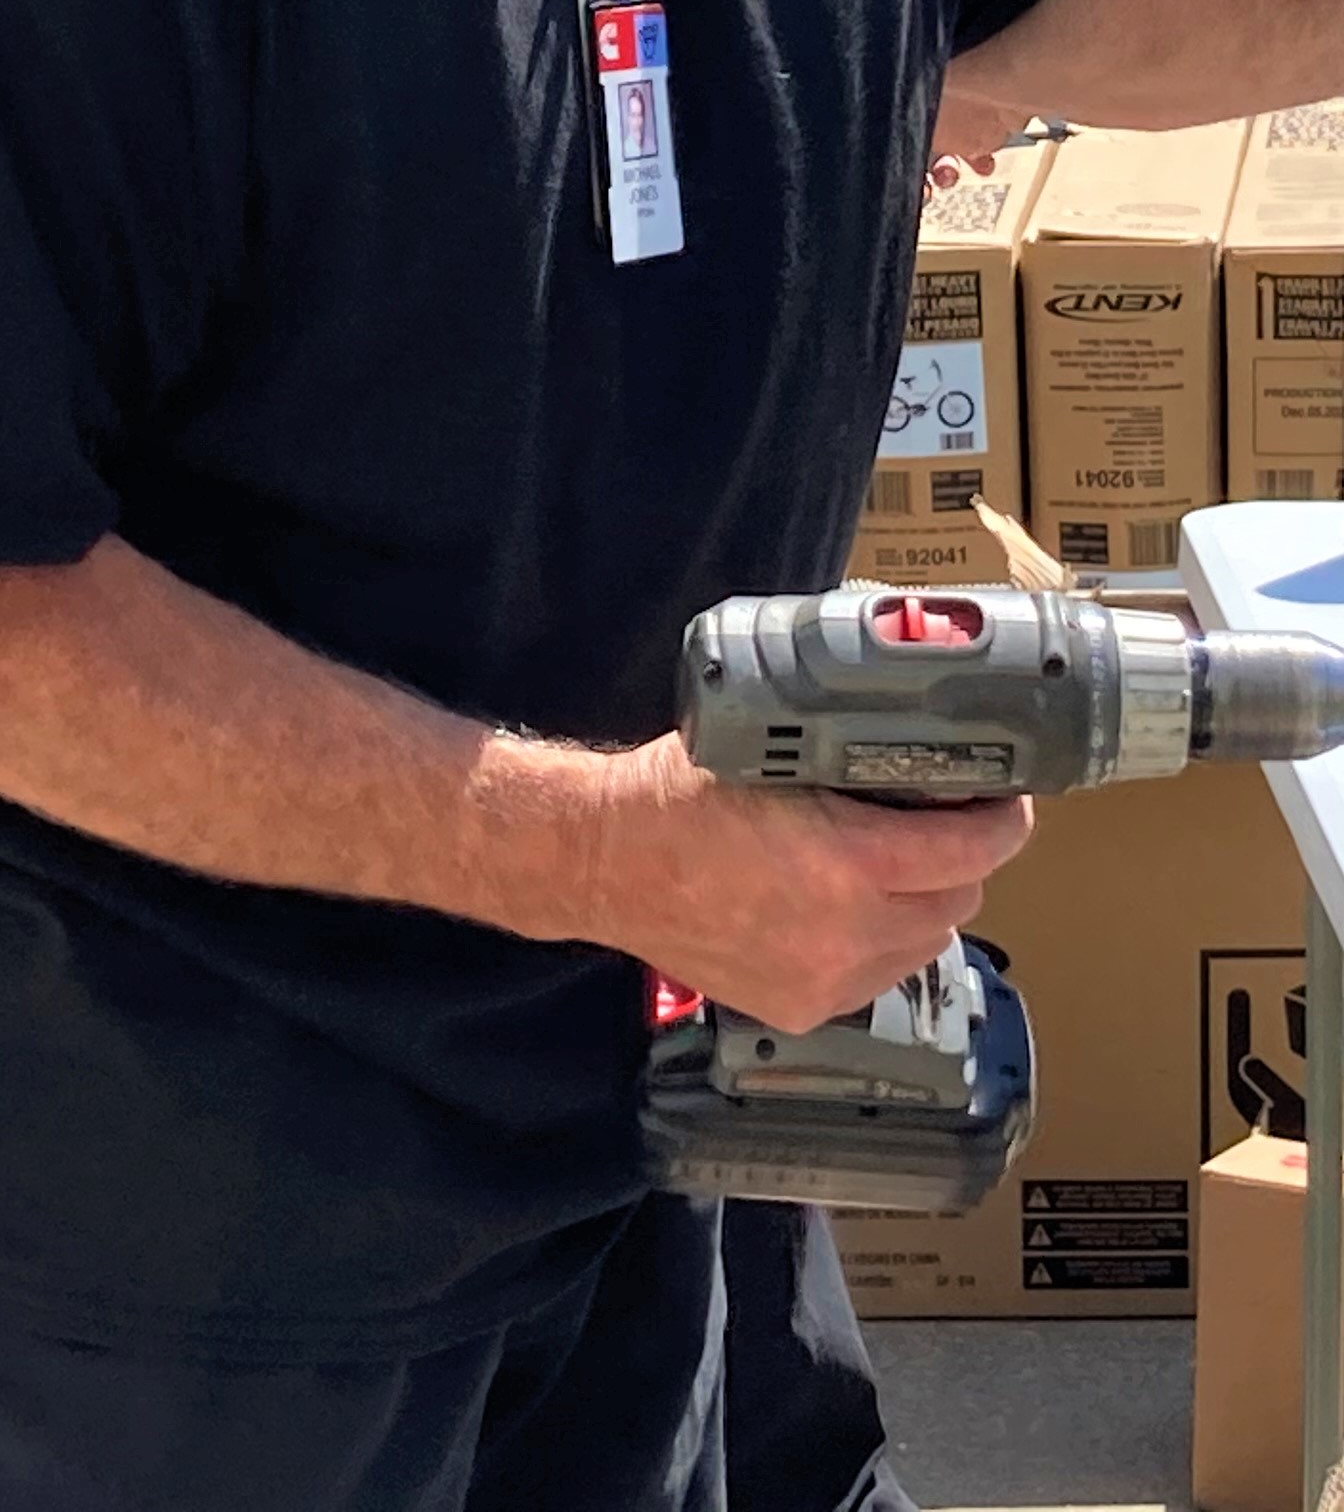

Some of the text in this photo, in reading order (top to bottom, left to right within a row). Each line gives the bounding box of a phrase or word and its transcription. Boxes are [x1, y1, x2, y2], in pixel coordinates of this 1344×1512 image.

[1059, 291, 1183, 314] KENT
[1073, 468, 1134, 489] 92041
[906, 545, 968, 567] 92041
